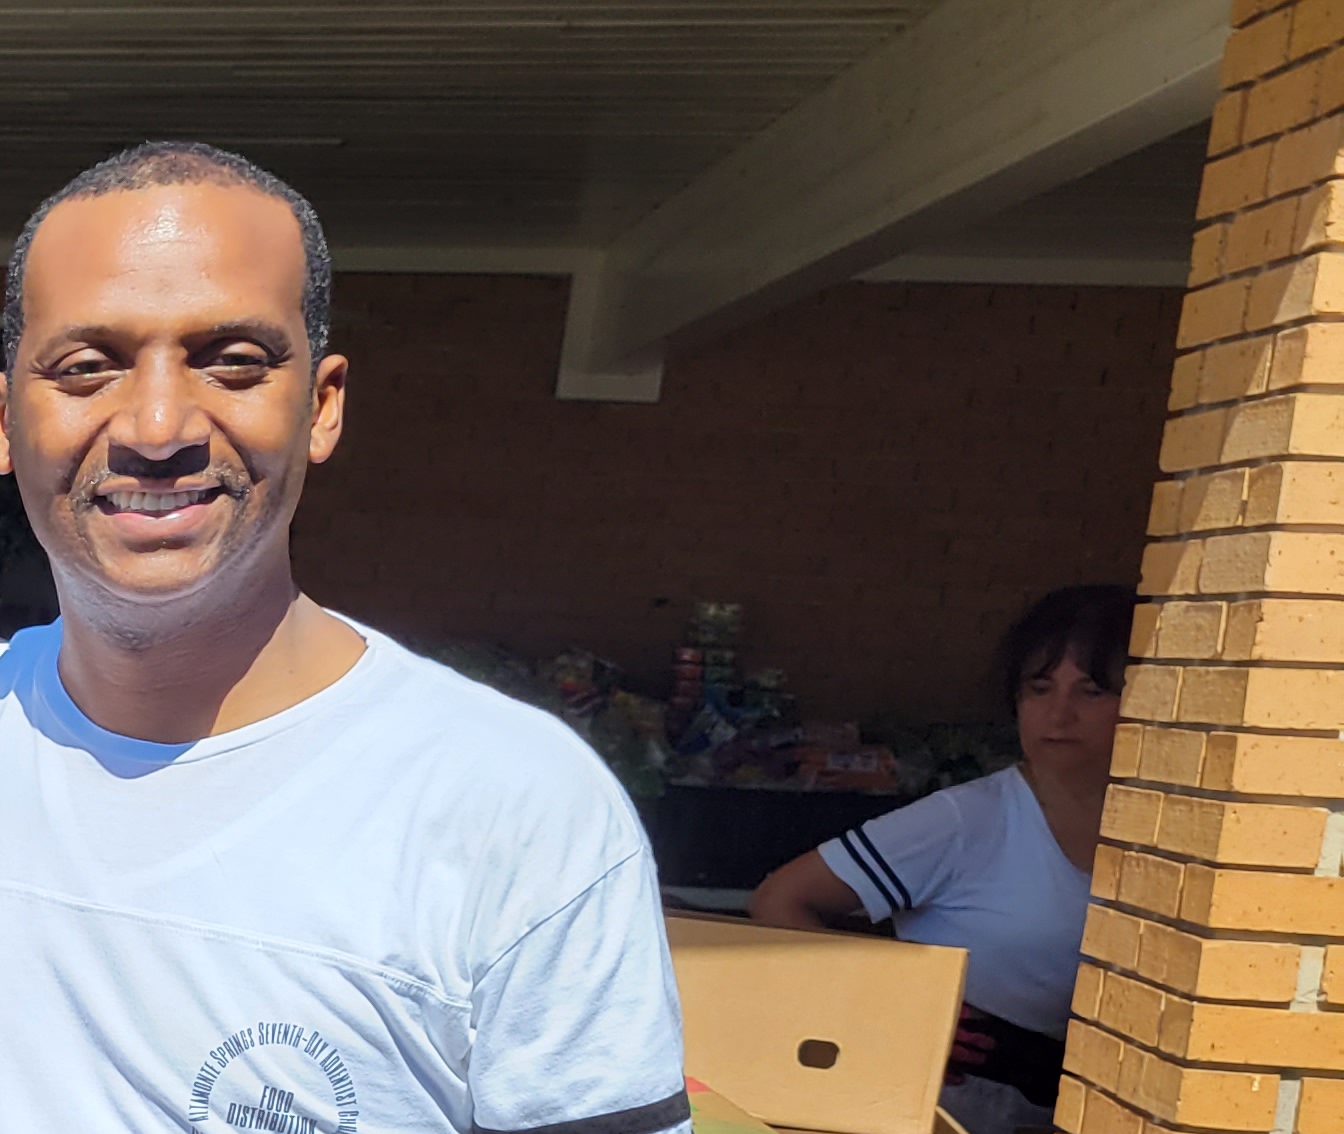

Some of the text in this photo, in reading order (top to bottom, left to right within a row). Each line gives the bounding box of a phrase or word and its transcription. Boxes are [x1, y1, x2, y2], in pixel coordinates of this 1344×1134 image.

[188, 1060, 221, 1123] ALTAMONTE
[209, 1027, 255, 1069] SPRINGS
[258, 1021, 329, 1060] SEVENTH-DAY
[319, 1048, 357, 1107] ADVENTIST
[259, 1085, 294, 1114] FOOD
